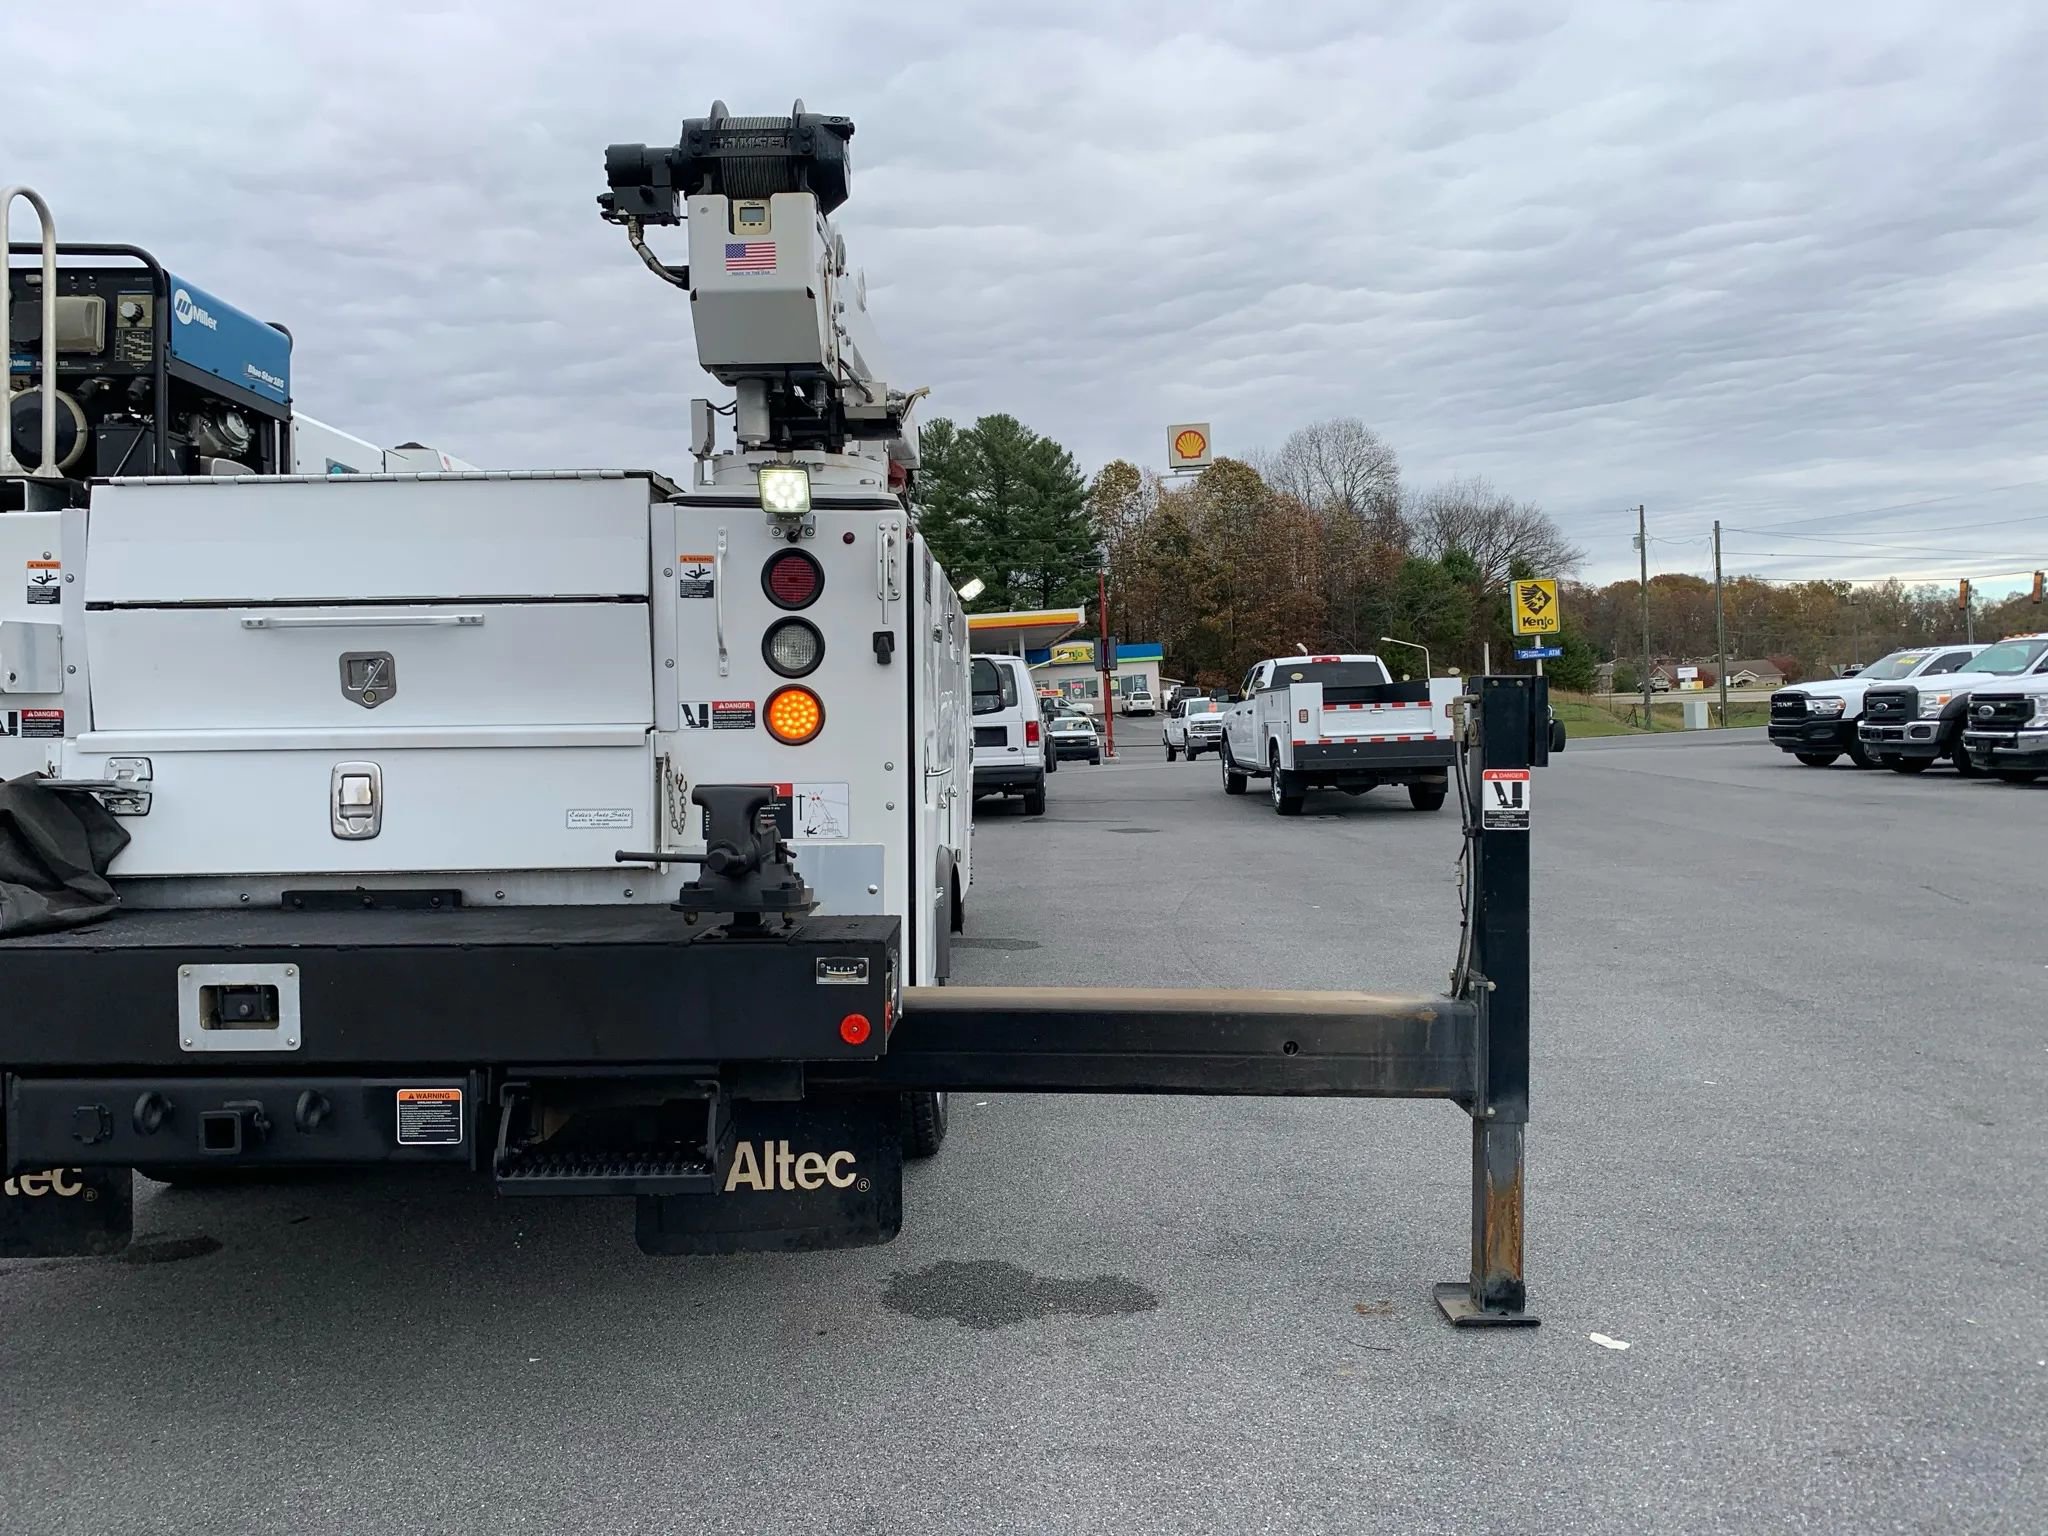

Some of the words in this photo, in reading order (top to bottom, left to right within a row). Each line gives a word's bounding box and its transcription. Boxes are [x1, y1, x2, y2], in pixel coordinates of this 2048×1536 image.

[193, 305, 217, 331] Miller
[1522, 616, 1554, 630] Kenjo
[415, 1092, 450, 1100] WARNING
[724, 1140, 857, 1191] Altec
